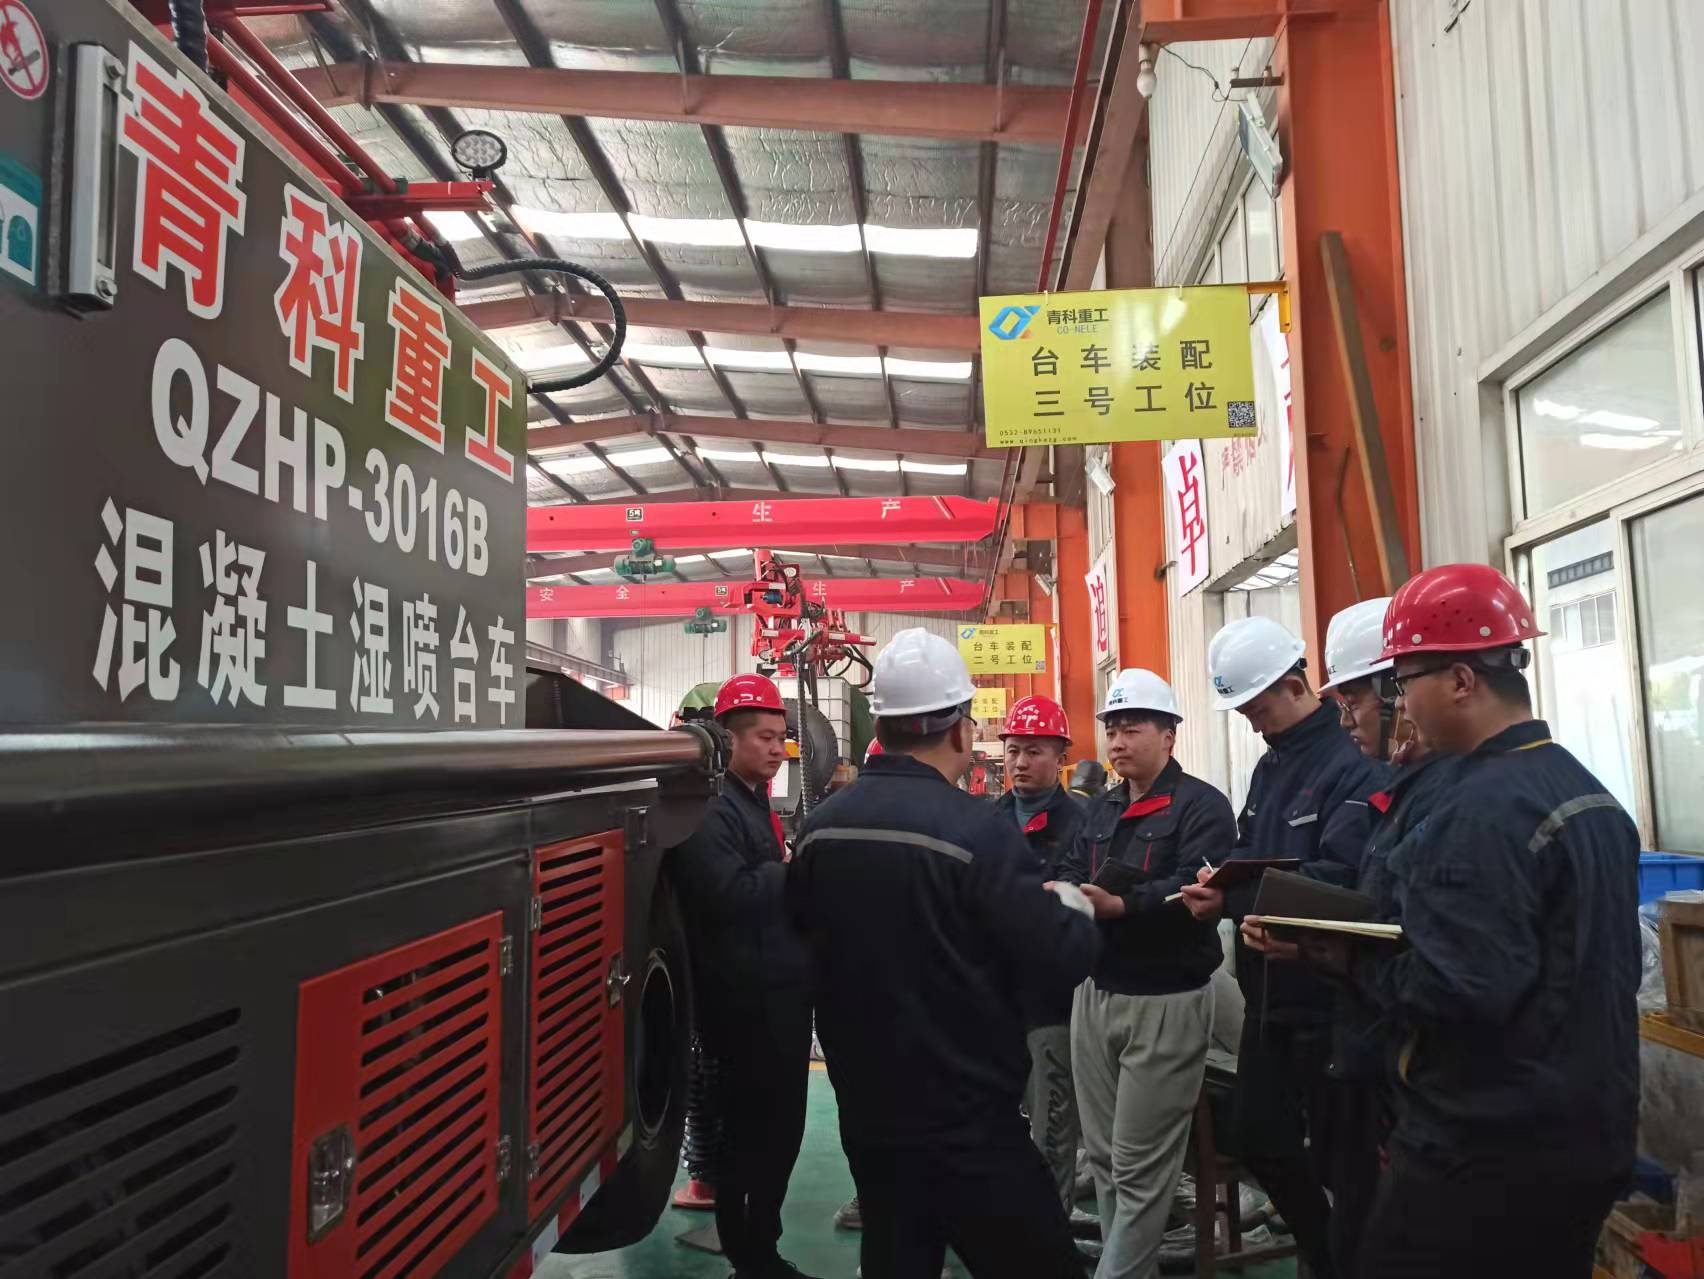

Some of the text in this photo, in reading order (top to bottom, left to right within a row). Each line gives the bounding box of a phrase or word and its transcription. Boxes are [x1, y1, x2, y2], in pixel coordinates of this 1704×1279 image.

[119, 40, 515, 484] 青科重工
[1047, 308, 1109, 325] 青科重工
[1031, 339, 1213, 377] 台车装配
[1033, 381, 1217, 417] 三号工位
[152, 338, 489, 577] QZHP-3016B
[1177, 452, 1205, 576] 卓
[93, 496, 515, 725] 混凝土湿喷台车
[973, 655, 1033, 665] 二号工位
[974, 640, 1032, 652] 台车装配
